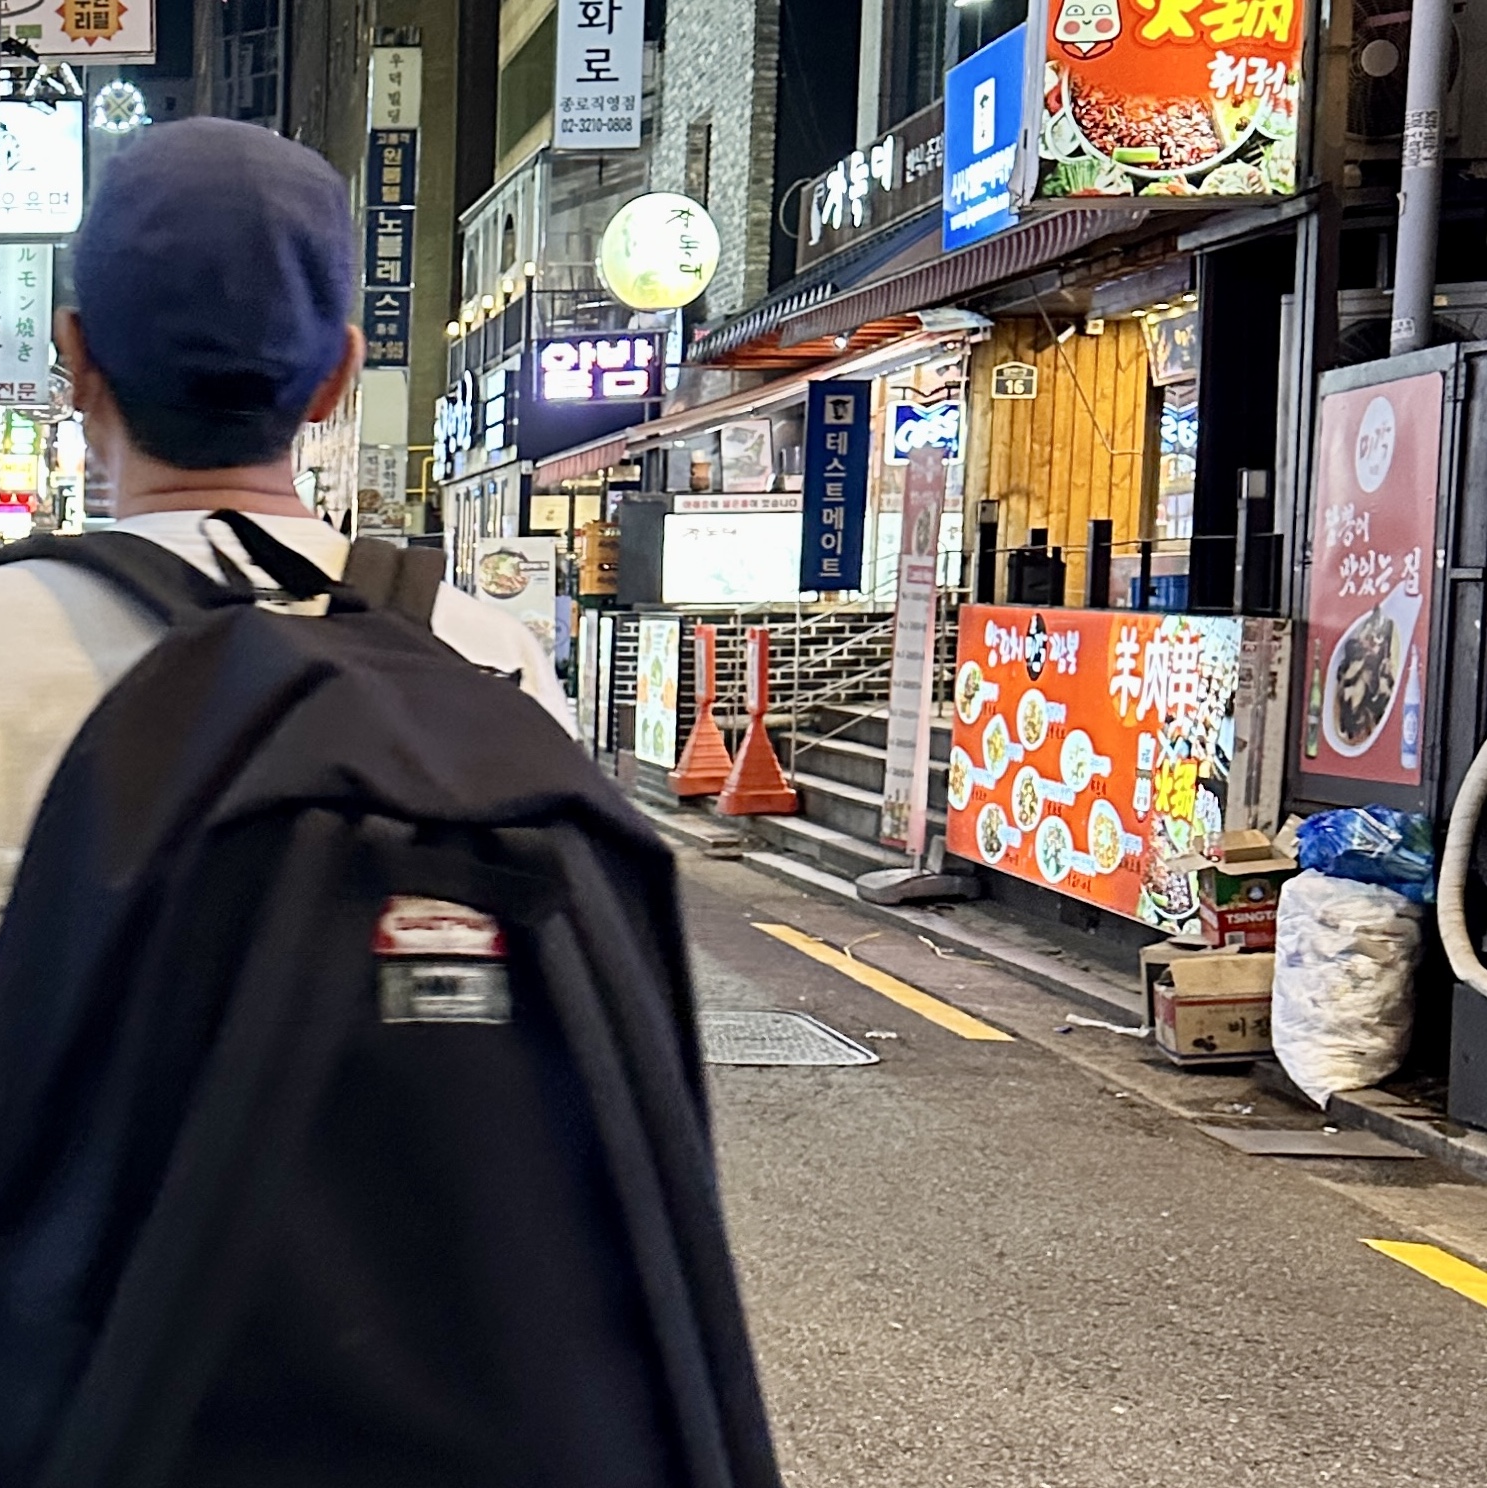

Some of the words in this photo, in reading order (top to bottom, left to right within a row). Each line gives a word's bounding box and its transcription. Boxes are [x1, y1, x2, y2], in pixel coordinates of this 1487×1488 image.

[74, 11, 109, 30] 리필
[560, 95, 635, 112] 종로직영점
[541, 339, 653, 399] 알밤
[1005, 379, 1025, 394] 16
[819, 431, 849, 577] 테스트메이트
[1339, 550, 1393, 597] 맛있는
[1401, 547, 1421, 594] 집
[1110, 626, 1199, 725] 羊肉串
[1226, 912, 1276, 924] TSINGT
